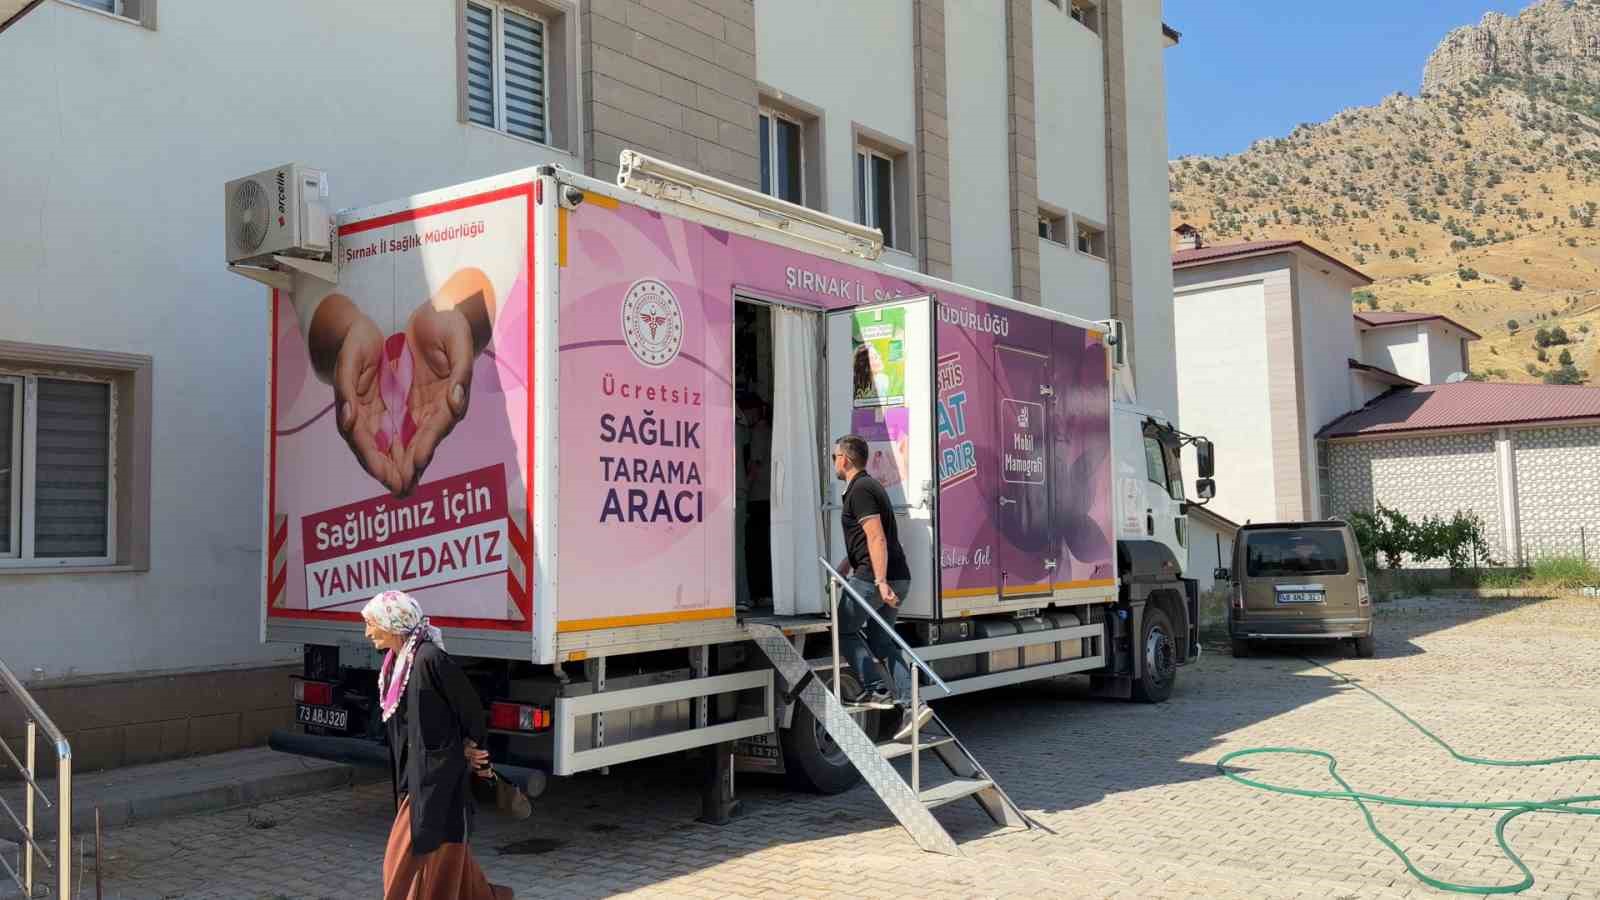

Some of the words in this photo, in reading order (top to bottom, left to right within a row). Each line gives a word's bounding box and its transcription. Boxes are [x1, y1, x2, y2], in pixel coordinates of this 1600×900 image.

[389, 234, 422, 252] Sağlık
[424, 220, 485, 245] Müdürlüğü
[786, 266, 850, 299] ŞIRNAK
[602, 373, 702, 406] Ücretsiz
[600, 409, 700, 449] SAĞLIK
[1014, 432, 1034, 451] Mobil
[600, 456, 702, 486] TARAMA
[1005, 453, 1043, 478] Mamografi
[315, 501, 436, 550] Sağlığınız
[442, 482, 493, 524] için
[600, 488, 703, 524] ARACI
[313, 530, 502, 598] YANINIZDAYIZ
[299, 706, 311, 721] 73
